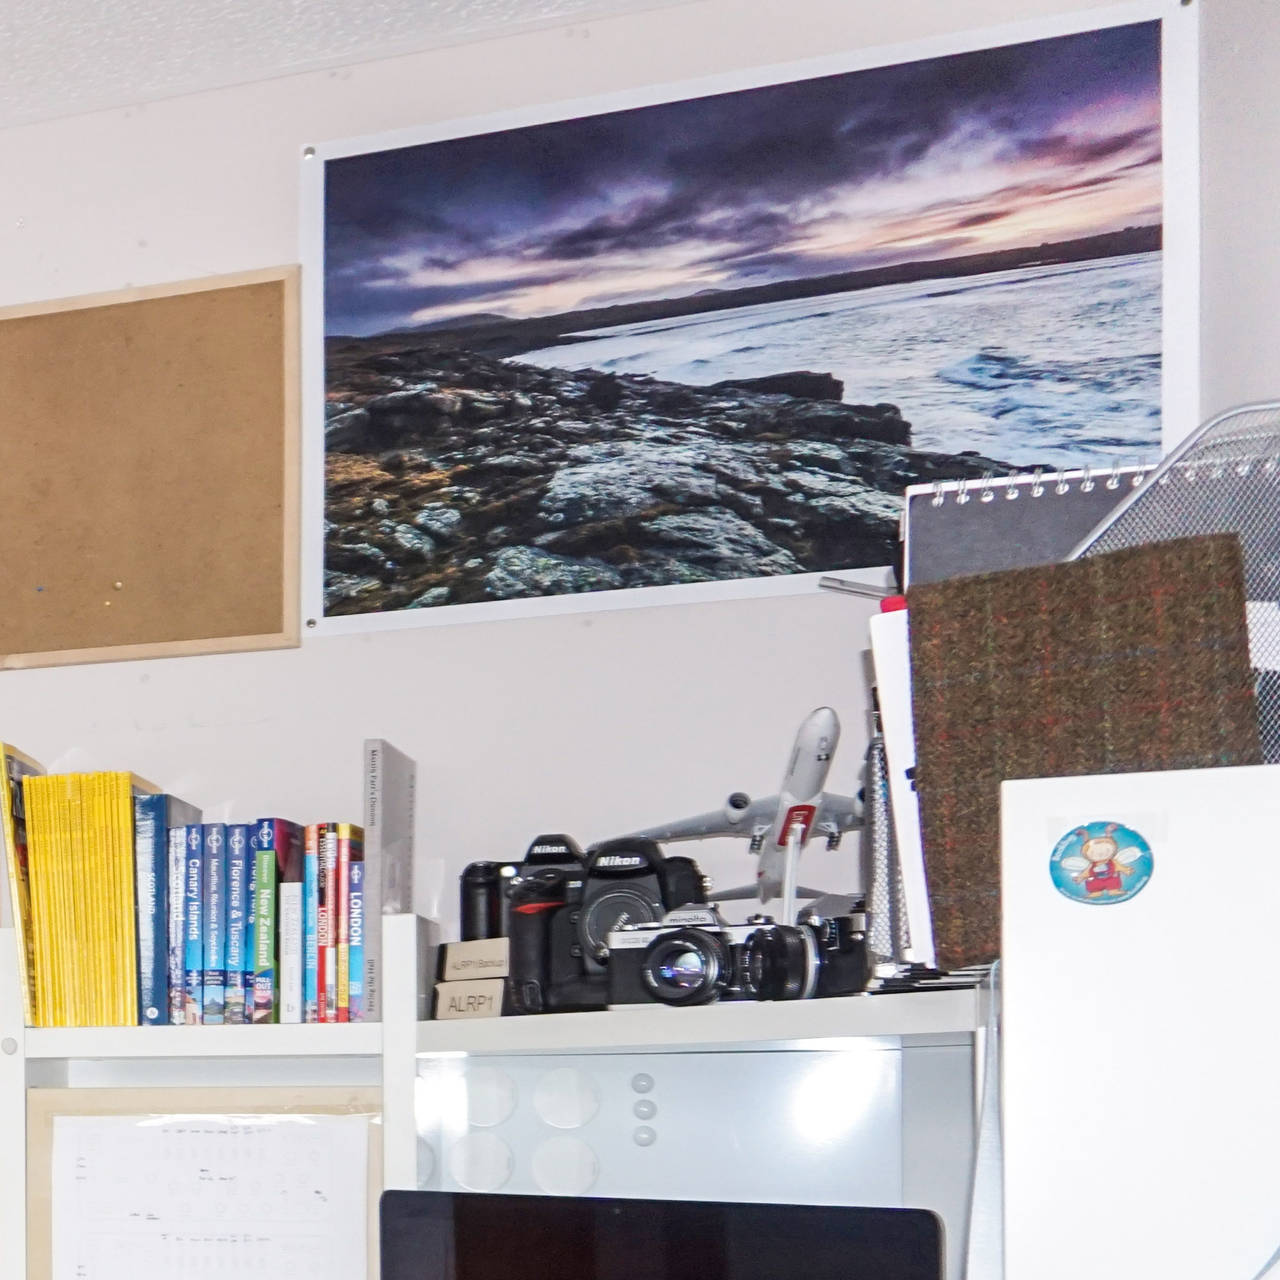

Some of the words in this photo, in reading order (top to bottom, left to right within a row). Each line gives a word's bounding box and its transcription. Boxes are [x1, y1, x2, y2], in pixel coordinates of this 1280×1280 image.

[533, 845, 567, 854] Nikon
[596, 855, 641, 867] Nikon
[146, 872, 156, 915] SCOTLAND
[188, 859, 201, 898] Canary
[231, 859, 243, 907] Florence
[188, 901, 201, 941] Islands
[231, 910, 243, 918] &
[259, 889, 272, 915] New
[350, 892, 363, 946] LONDON
[669, 914, 707, 923] minolta
[228, 921, 243, 967] Tuscany
[258, 918, 272, 967] Zealand
[318, 907, 328, 946] LONDON
[306, 935, 317, 969] BERLIN
[448, 994, 494, 1012] ALRP1
